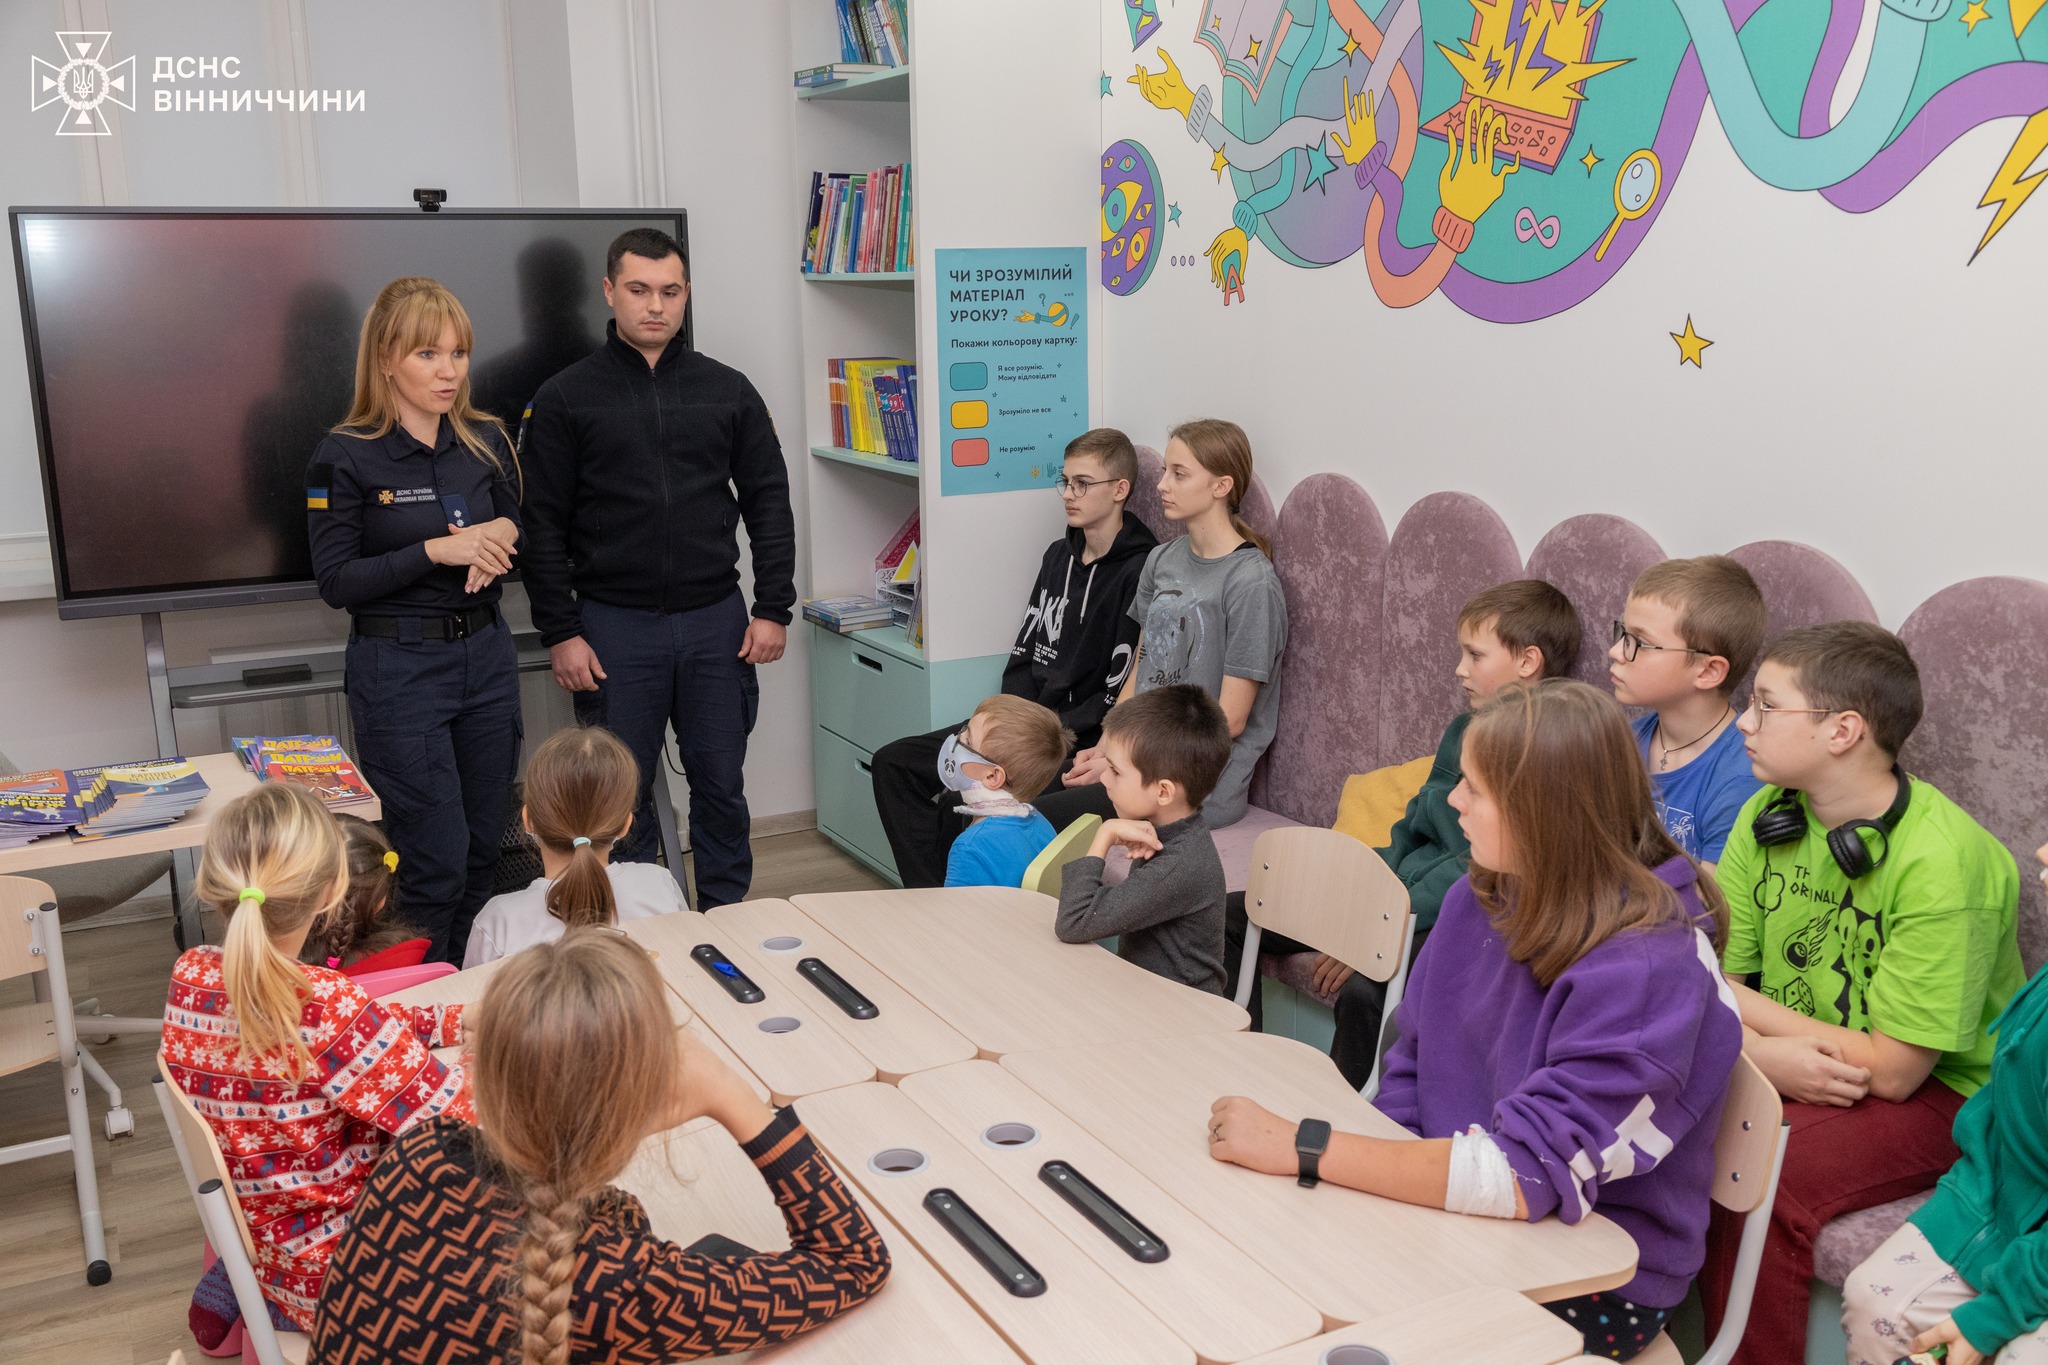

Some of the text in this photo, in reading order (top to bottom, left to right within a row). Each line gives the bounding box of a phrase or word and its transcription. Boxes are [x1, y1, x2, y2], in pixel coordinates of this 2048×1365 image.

[949, 263, 1072, 283] ЧИ ЗРОЗУМІЛИЙ
[950, 288, 1025, 303] МАТЕРІАЛ
[950, 308, 1008, 323] УРОКУ?
[951, 335, 1078, 349] Покажи кольорову картку:
[998, 372, 1057, 382] Можу відповідати
[998, 407, 1031, 417] Зрозуміло
[1009, 444, 1036, 454] розумію
